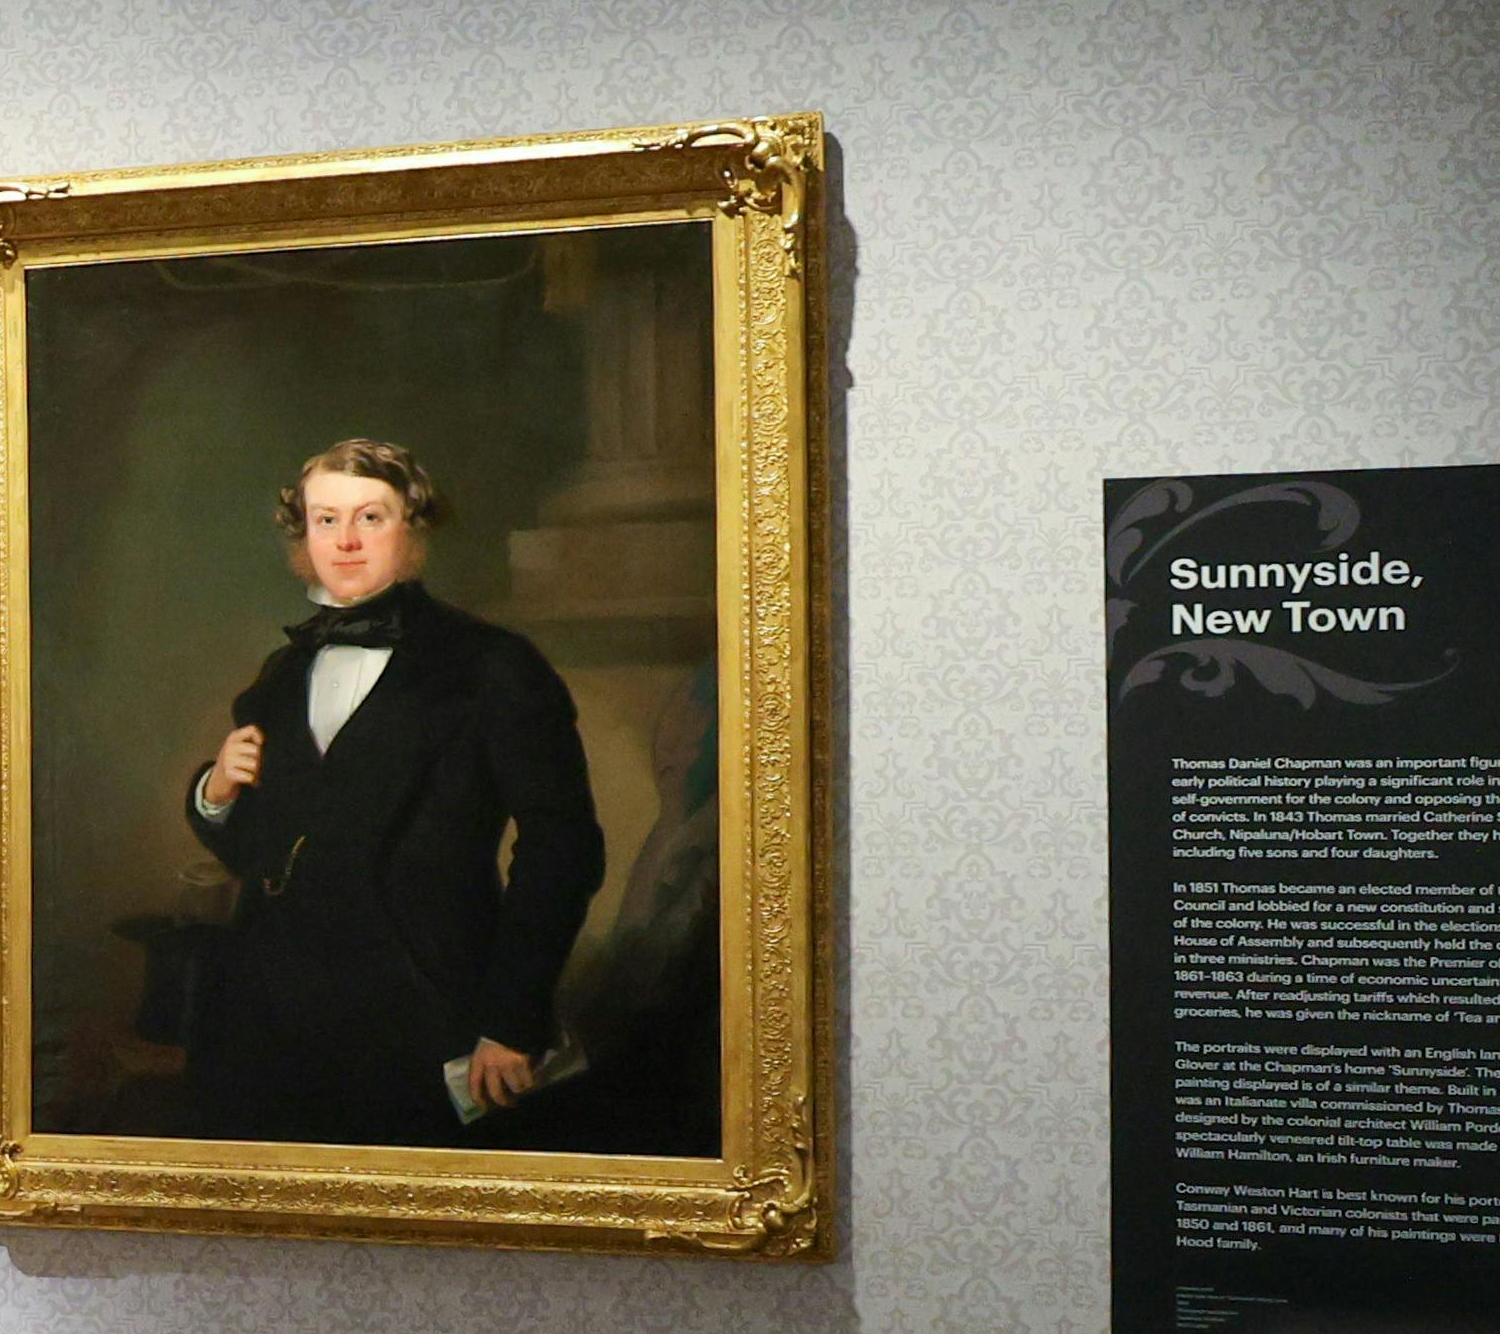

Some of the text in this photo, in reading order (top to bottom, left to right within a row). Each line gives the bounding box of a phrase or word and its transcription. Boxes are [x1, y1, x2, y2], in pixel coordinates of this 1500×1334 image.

[1171, 552, 1422, 593] Sunnyside,
[1173, 601, 1404, 634] New Town
[1171, 757, 1226, 768] Thomas
[1228, 757, 1271, 768] Daniel
[1274, 757, 1342, 770] Chapman
[1344, 759, 1373, 768] was
[1375, 759, 1393, 768] an
[1396, 756, 1466, 770] important
[1171, 774, 1500, 789] early political history playing a significant role in
[1171, 793, 1282, 806] self-government
[1285, 793, 1306, 804] for
[1308, 793, 1332, 804] the
[1334, 793, 1382, 806] colony
[1384, 793, 1412, 804] and
[1414, 793, 1482, 806] opposing
[1172, 811, 1494, 822] of convicts. In 1843 Thomas married Catherine
[1172, 829, 1489, 843] Church, Nipaluna/Hobart Town. Together they
[1172, 847, 1438, 861] including five sons and four daughters.
[1173, 882, 1494, 895] In 1851 Thomas became an elected member of
[1173, 900, 1495, 913] Council and lobbied for a new constitution and
[1172, 917, 1188, 928] of
[1190, 917, 1213, 929] the
[1215, 918, 1263, 931] colony.
[1267, 918, 1287, 929] He
[1289, 921, 1318, 930] was
[1320, 919, 1394, 930] successful
[1397, 919, 1411, 930] in
[1413, 920, 1437, 931] the
[1173, 935, 1492, 951] House of Assembly and subsequently held the
[1173, 953, 1485, 968] in three ministries. Chapman was the Premier
